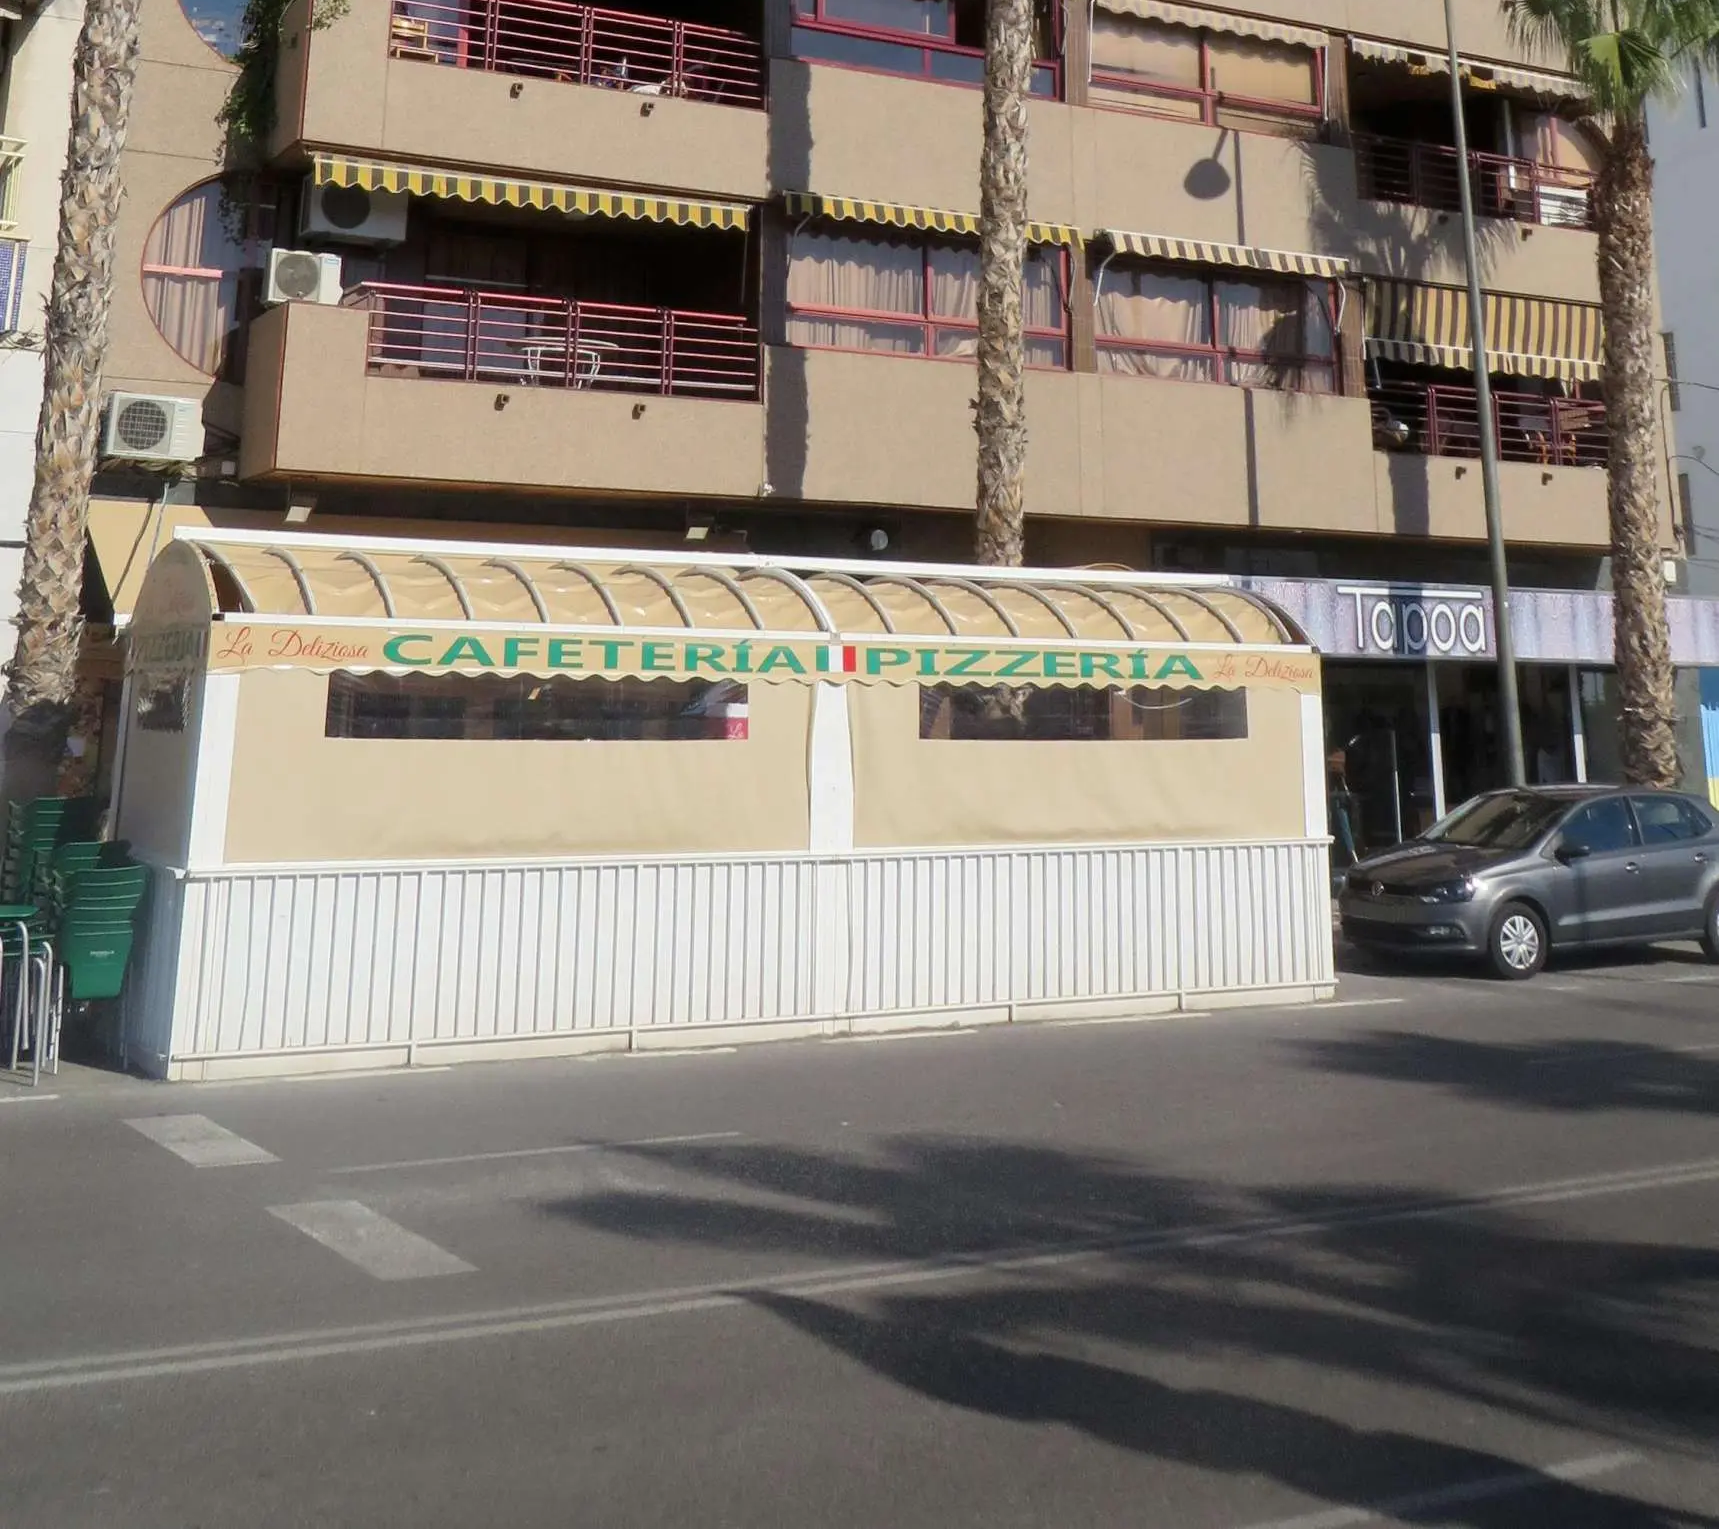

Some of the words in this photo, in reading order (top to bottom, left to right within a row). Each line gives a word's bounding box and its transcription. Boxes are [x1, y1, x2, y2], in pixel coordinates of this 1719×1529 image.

[1337, 586, 1485, 653] Tapoa
[217, 627, 252, 664] La
[268, 630, 368, 662] Deliziosa
[383, 634, 807, 674] CAFETERÍA
[866, 647, 1204, 681] PIZZERÍA
[1245, 655, 1313, 682] Deliziosa
